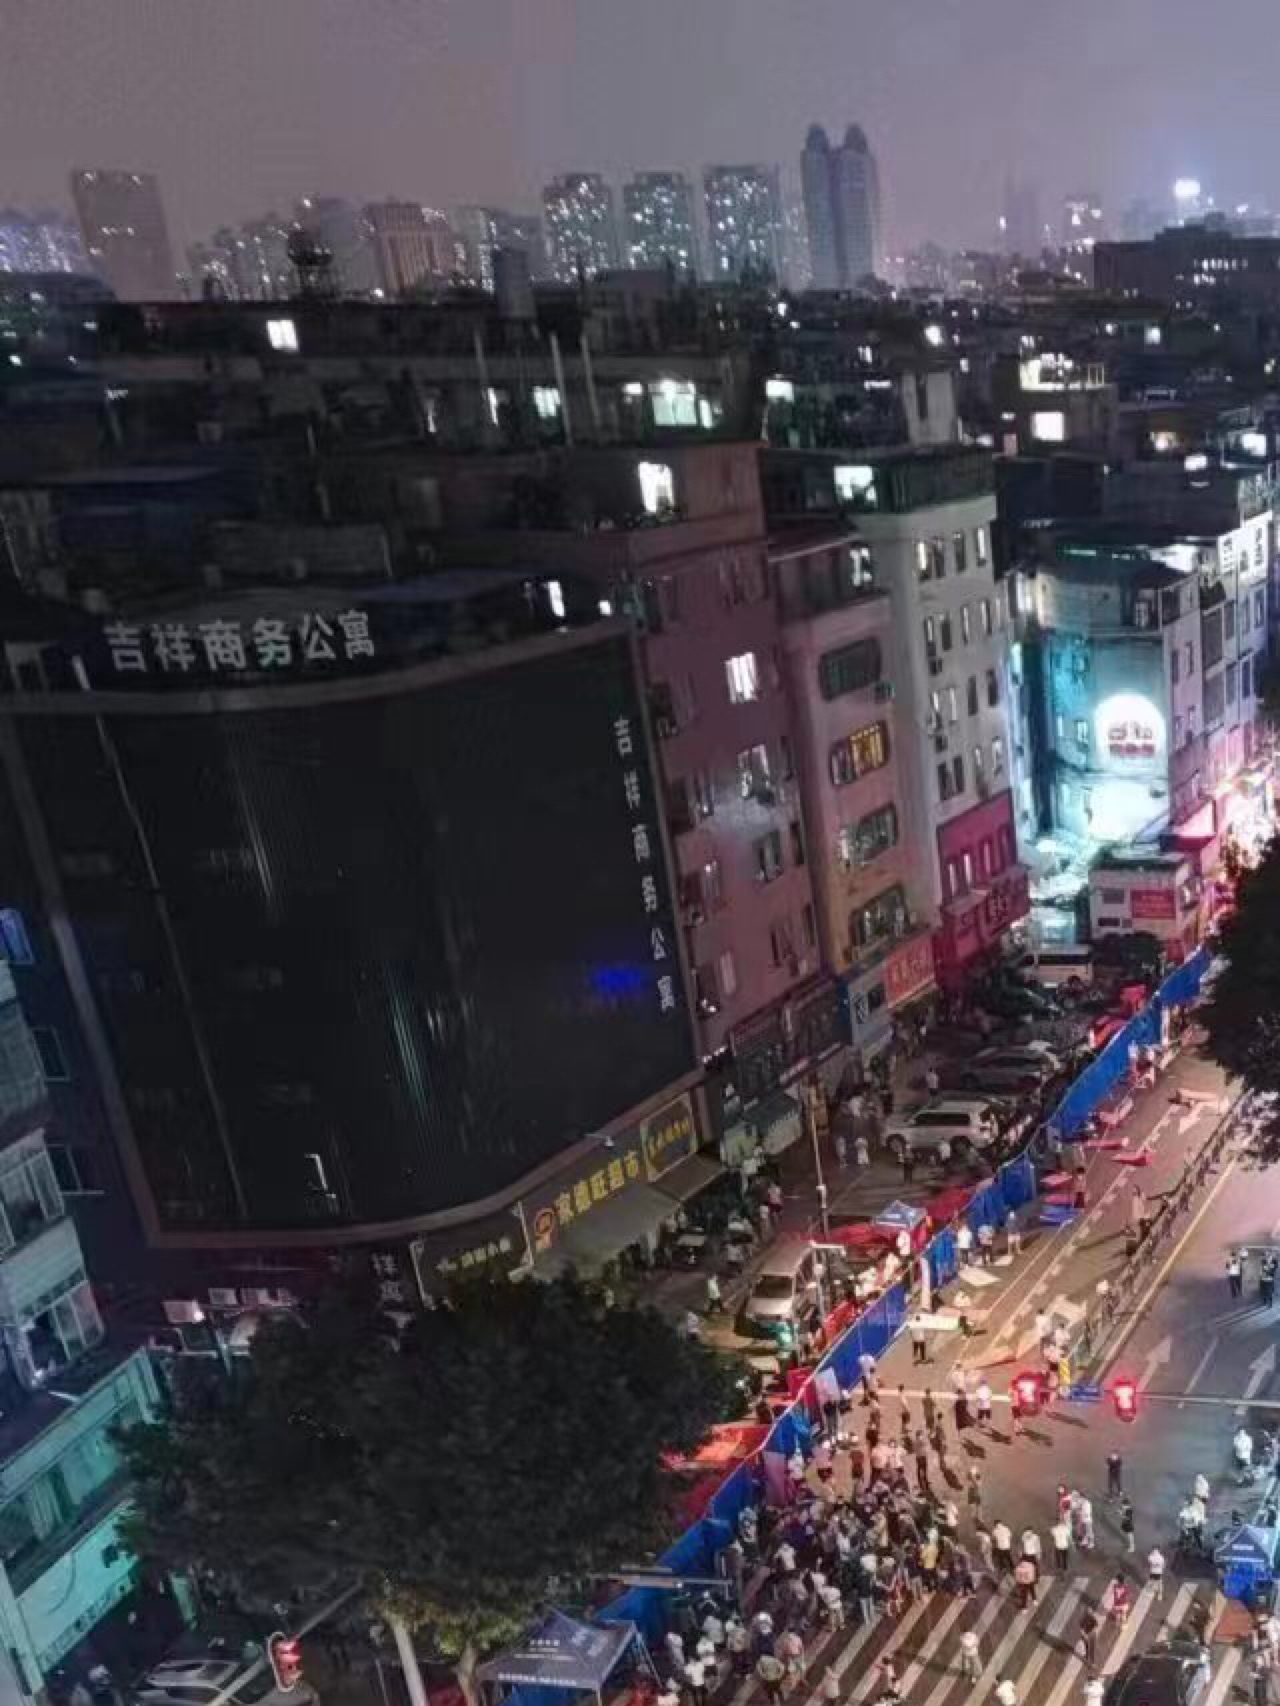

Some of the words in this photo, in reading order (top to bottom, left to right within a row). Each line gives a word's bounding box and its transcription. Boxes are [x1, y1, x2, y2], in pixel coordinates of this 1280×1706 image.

[103, 609, 375, 673] 吉祥商务公寓
